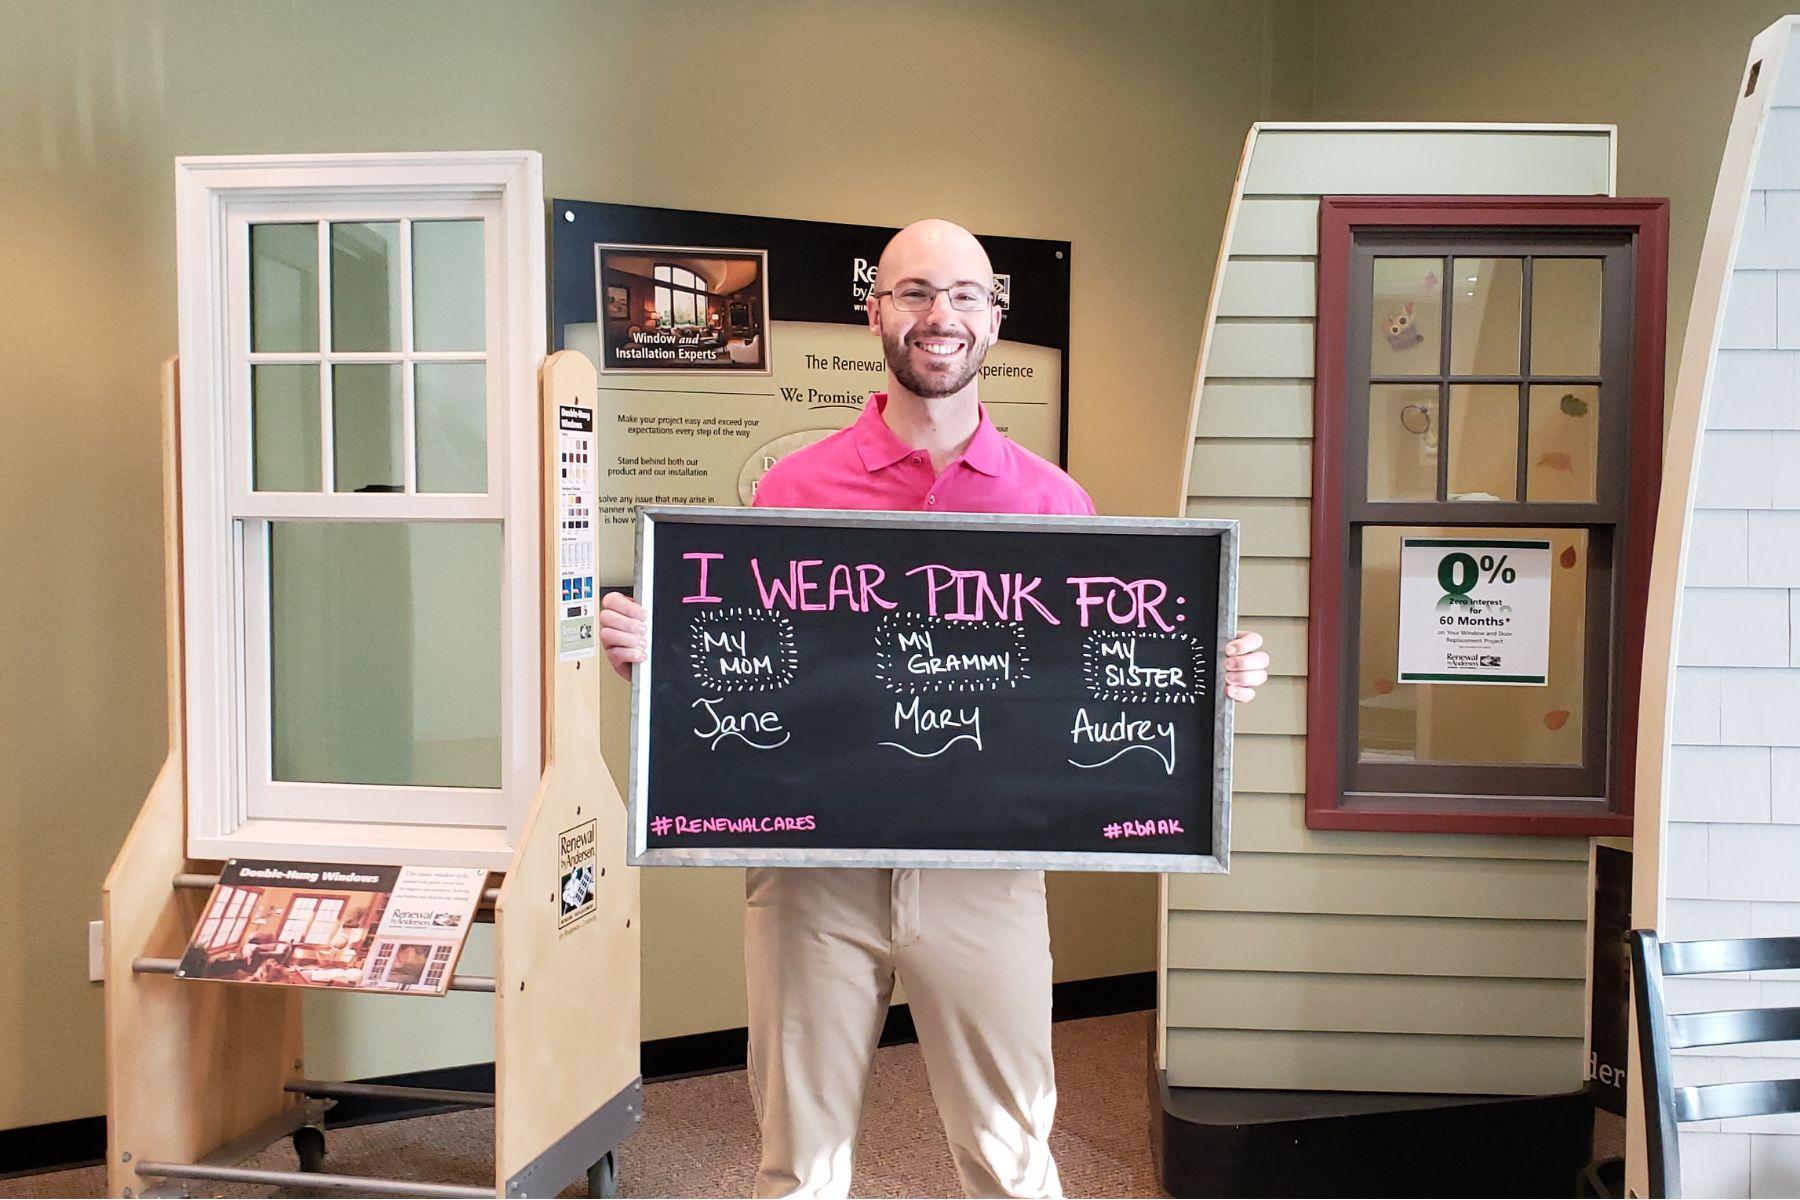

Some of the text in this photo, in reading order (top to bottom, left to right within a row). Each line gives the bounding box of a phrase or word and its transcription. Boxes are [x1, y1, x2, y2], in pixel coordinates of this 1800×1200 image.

[853, 284, 868, 301] by
[633, 332, 700, 345] Window and
[615, 347, 717, 362] Installation Experts
[805, 354, 828, 370] The
[832, 356, 886, 372] Renewal
[780, 387, 864, 404] We Promise
[617, 414, 760, 428] Make your project easy and exceed your
[628, 427, 750, 438] expectations every step of the way
[618, 456, 639, 465] Stand
[640, 457, 666, 465] behind
[667, 457, 685, 465] both
[608, 468, 637, 477] product
[638, 468, 652, 476] and
[668, 468, 708, 476] installation
[620, 496, 633, 505] any
[635, 495, 653, 504] issue
[655, 495, 670, 504] that
[672, 497, 687, 505] may
[688, 495, 706, 504] arise
[604, 516, 611, 524] is
[613, 516, 629, 524] how
[1437, 552, 1516, 595] 0%
[682, 552, 1187, 632] I WEAR PINK FOR:
[1449, 598, 1502, 606] Zero Interest
[1439, 616, 1454, 625] 60
[720, 655, 773, 676] MOM
[1446, 653, 1478, 661] Renewal
[907, 651, 1010, 681] GRAMMY
[1105, 664, 1188, 688] SISTER
[692, 697, 783, 738] Jane
[895, 696, 983, 751] Mary
[1070, 708, 1176, 775] Audrey
[650, 815, 817, 836] #RENEWALCARES
[560, 824, 594, 856] Renewal
[567, 846, 595, 868] Andersen
[239, 867, 380, 883] Double-Hung Windows
[392, 908, 433, 920] Renewal
